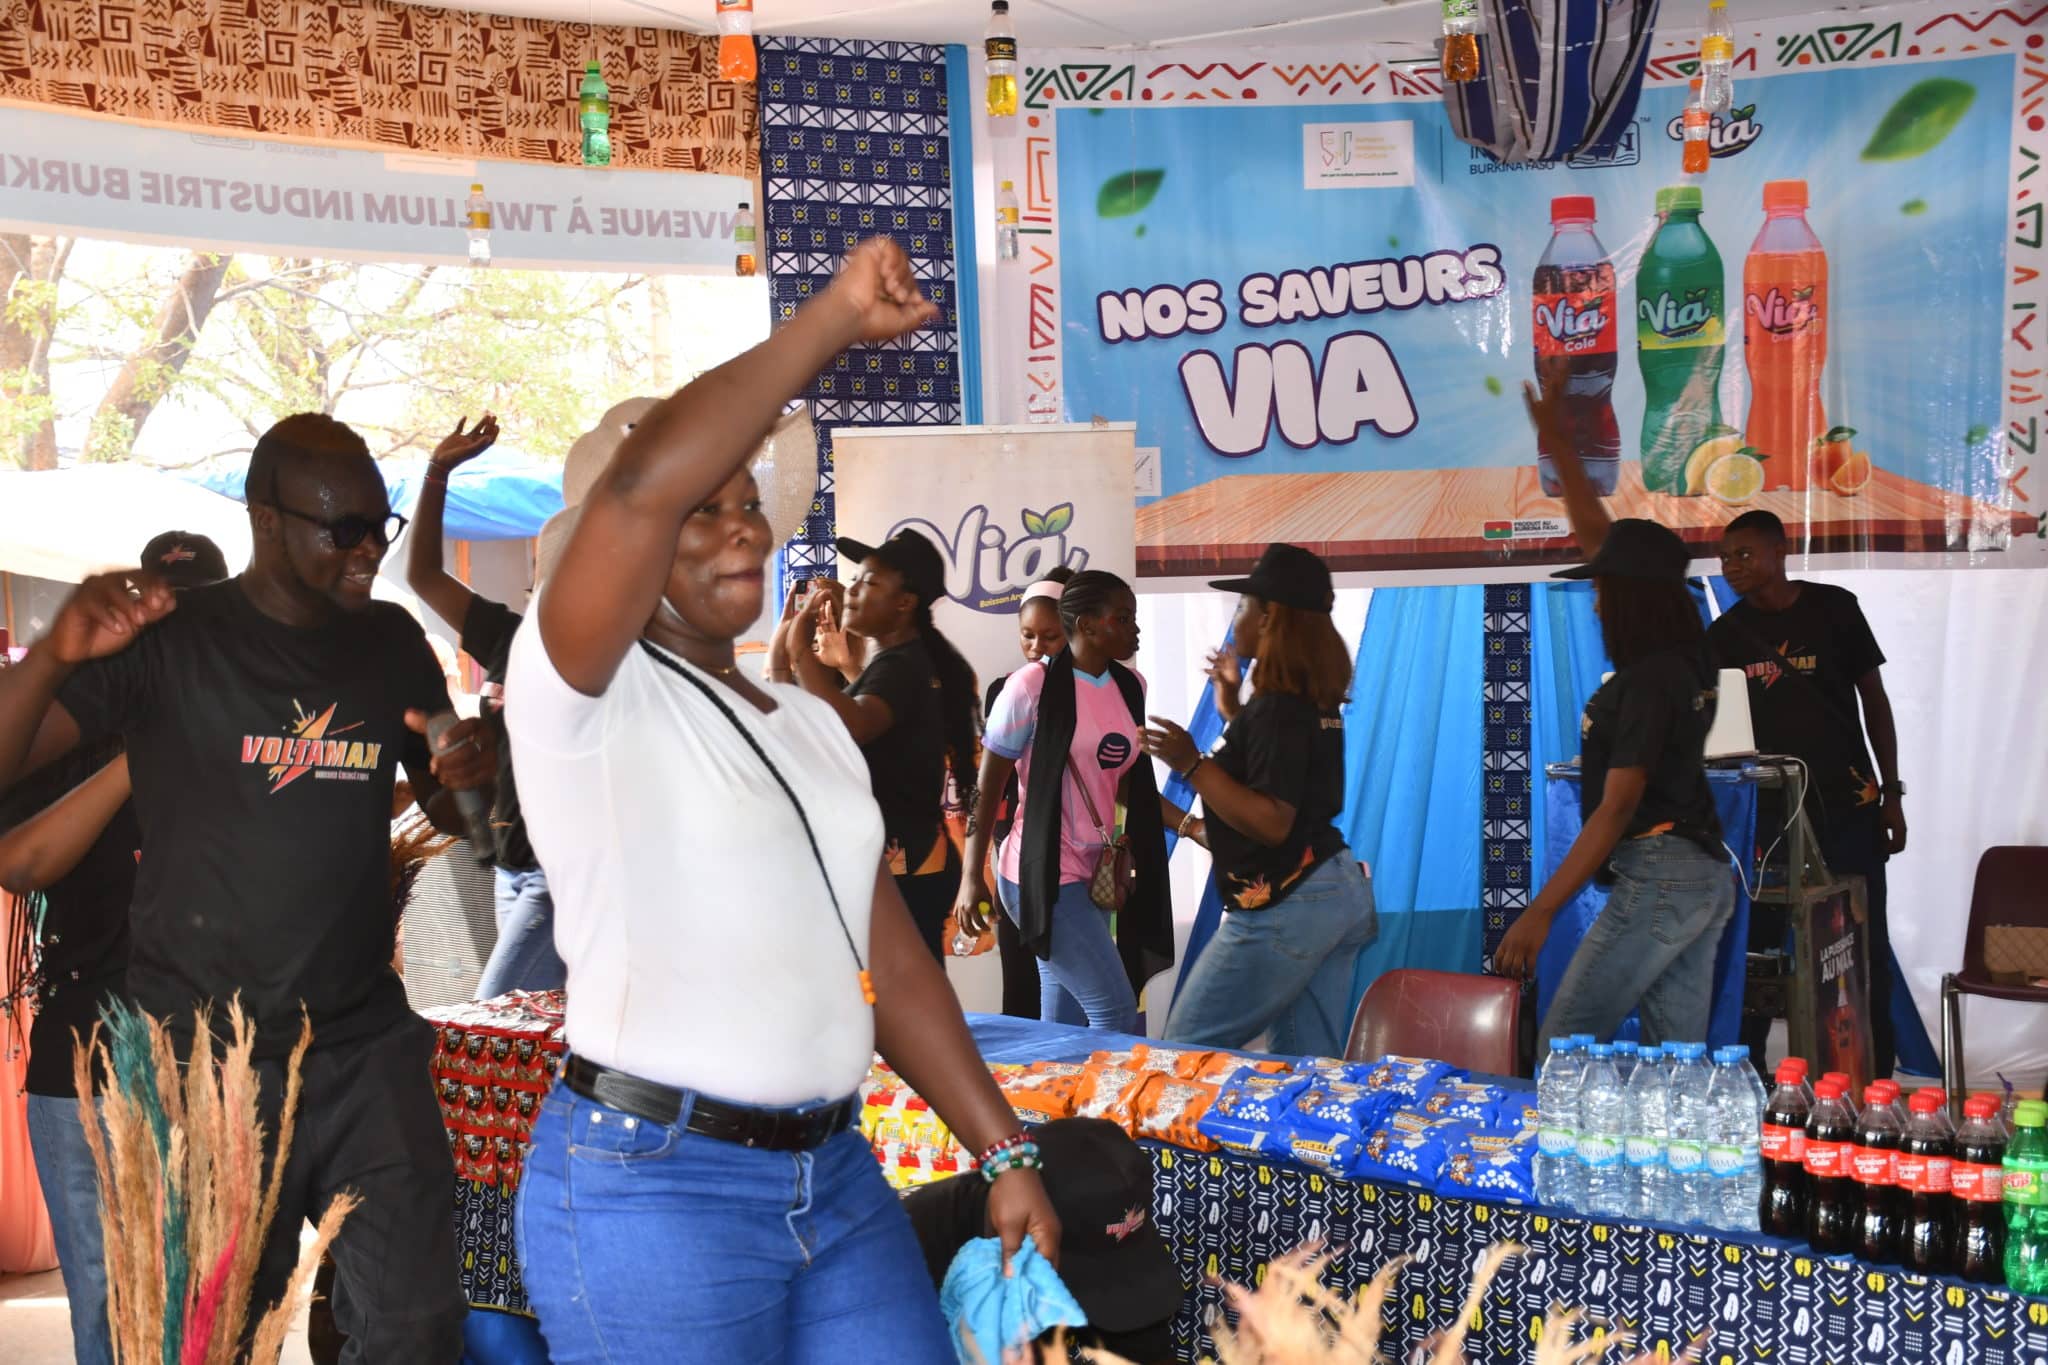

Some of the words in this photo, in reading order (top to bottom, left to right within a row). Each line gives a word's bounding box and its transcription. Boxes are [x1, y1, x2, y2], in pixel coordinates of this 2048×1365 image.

[1667, 113, 1762, 150] ia
[1470, 161, 1523, 175] BURKINA
[1097, 279, 1227, 344] NOS
[1239, 243, 1507, 328] SAVEURS
[1639, 291, 1711, 332] Via
[1746, 287, 1818, 330] Via
[1536, 298, 1608, 338] Via
[1565, 338, 1597, 352] Cola
[1178, 330, 1418, 458] VIA
[886, 504, 1089, 601] Via
[241, 735, 382, 770] VOLTAMAX
